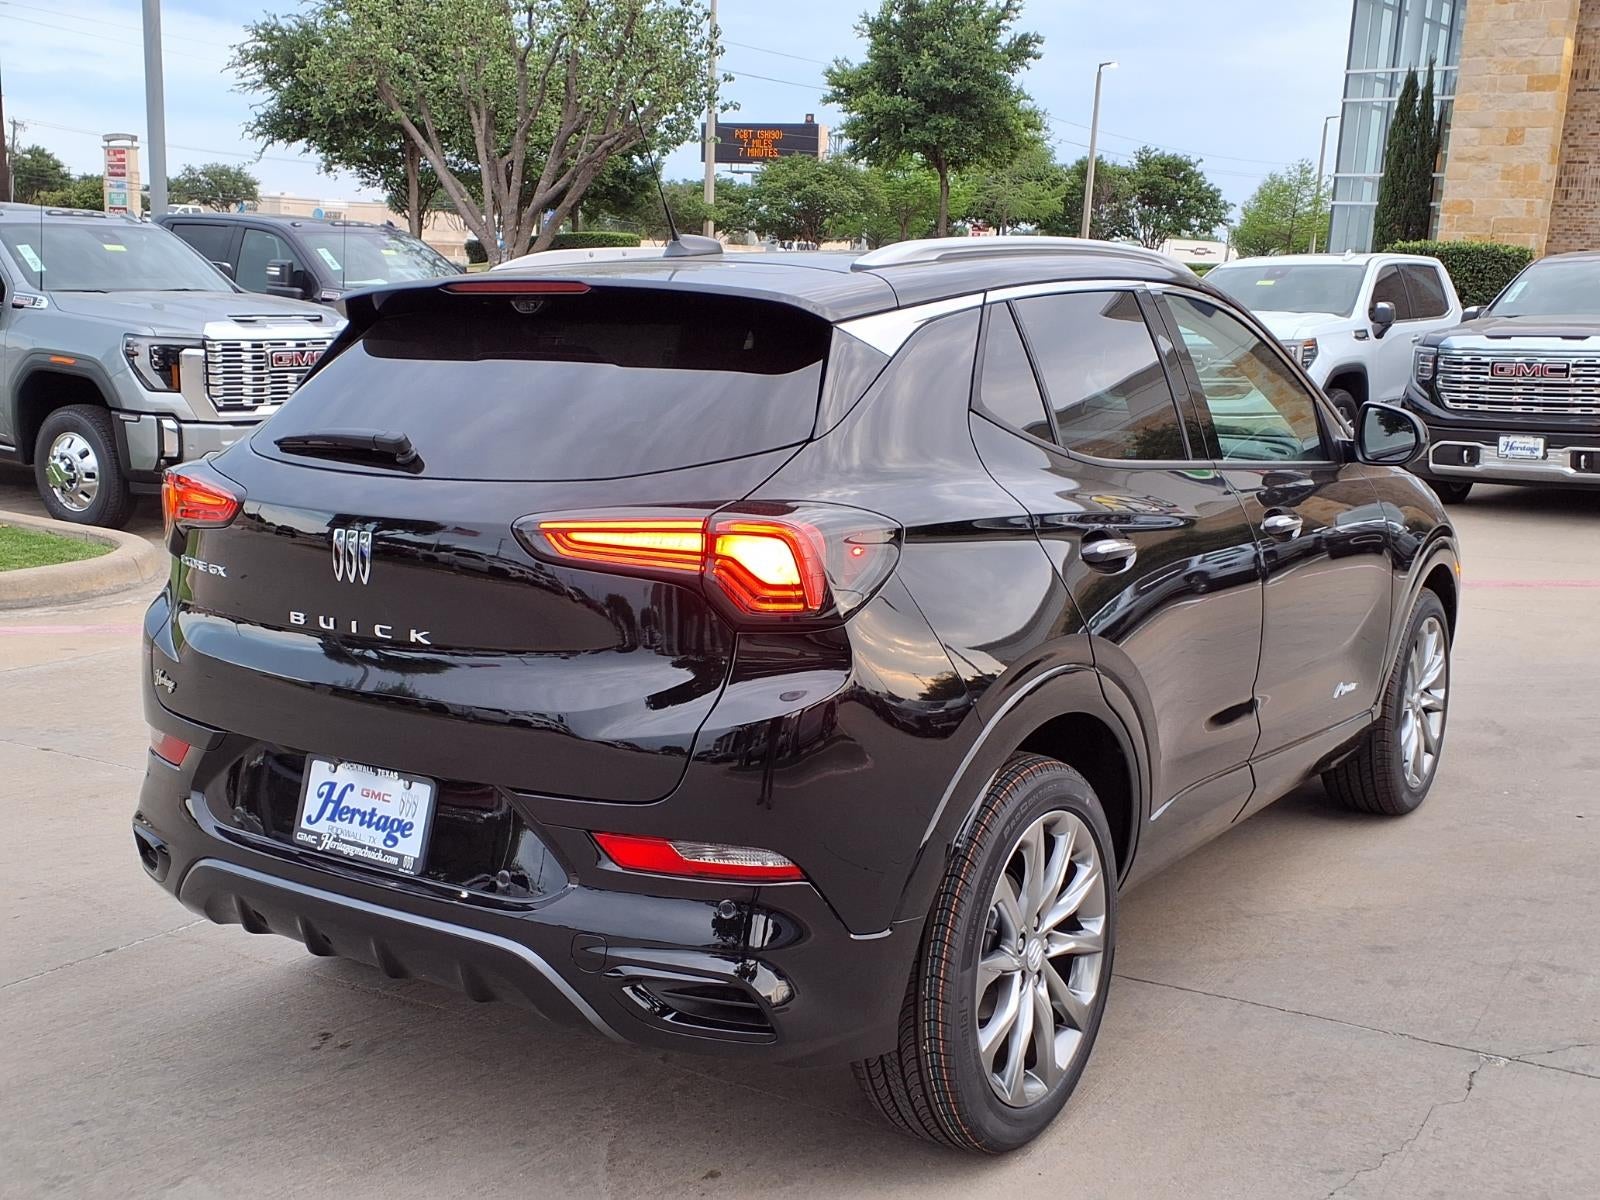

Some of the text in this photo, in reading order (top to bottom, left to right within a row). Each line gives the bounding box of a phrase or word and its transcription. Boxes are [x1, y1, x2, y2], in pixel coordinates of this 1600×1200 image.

[743, 139, 773, 148] 7 MILES
[738, 147, 778, 158] 7 MINUTES
[1493, 363, 1567, 378] GMC
[1501, 440, 1540, 455] Heritage
[289, 611, 432, 645] BUICK
[377, 768, 399, 781] TEXAS
[361, 787, 392, 803] GMC
[306, 780, 414, 848] Heritage
[296, 831, 318, 844] GMC
